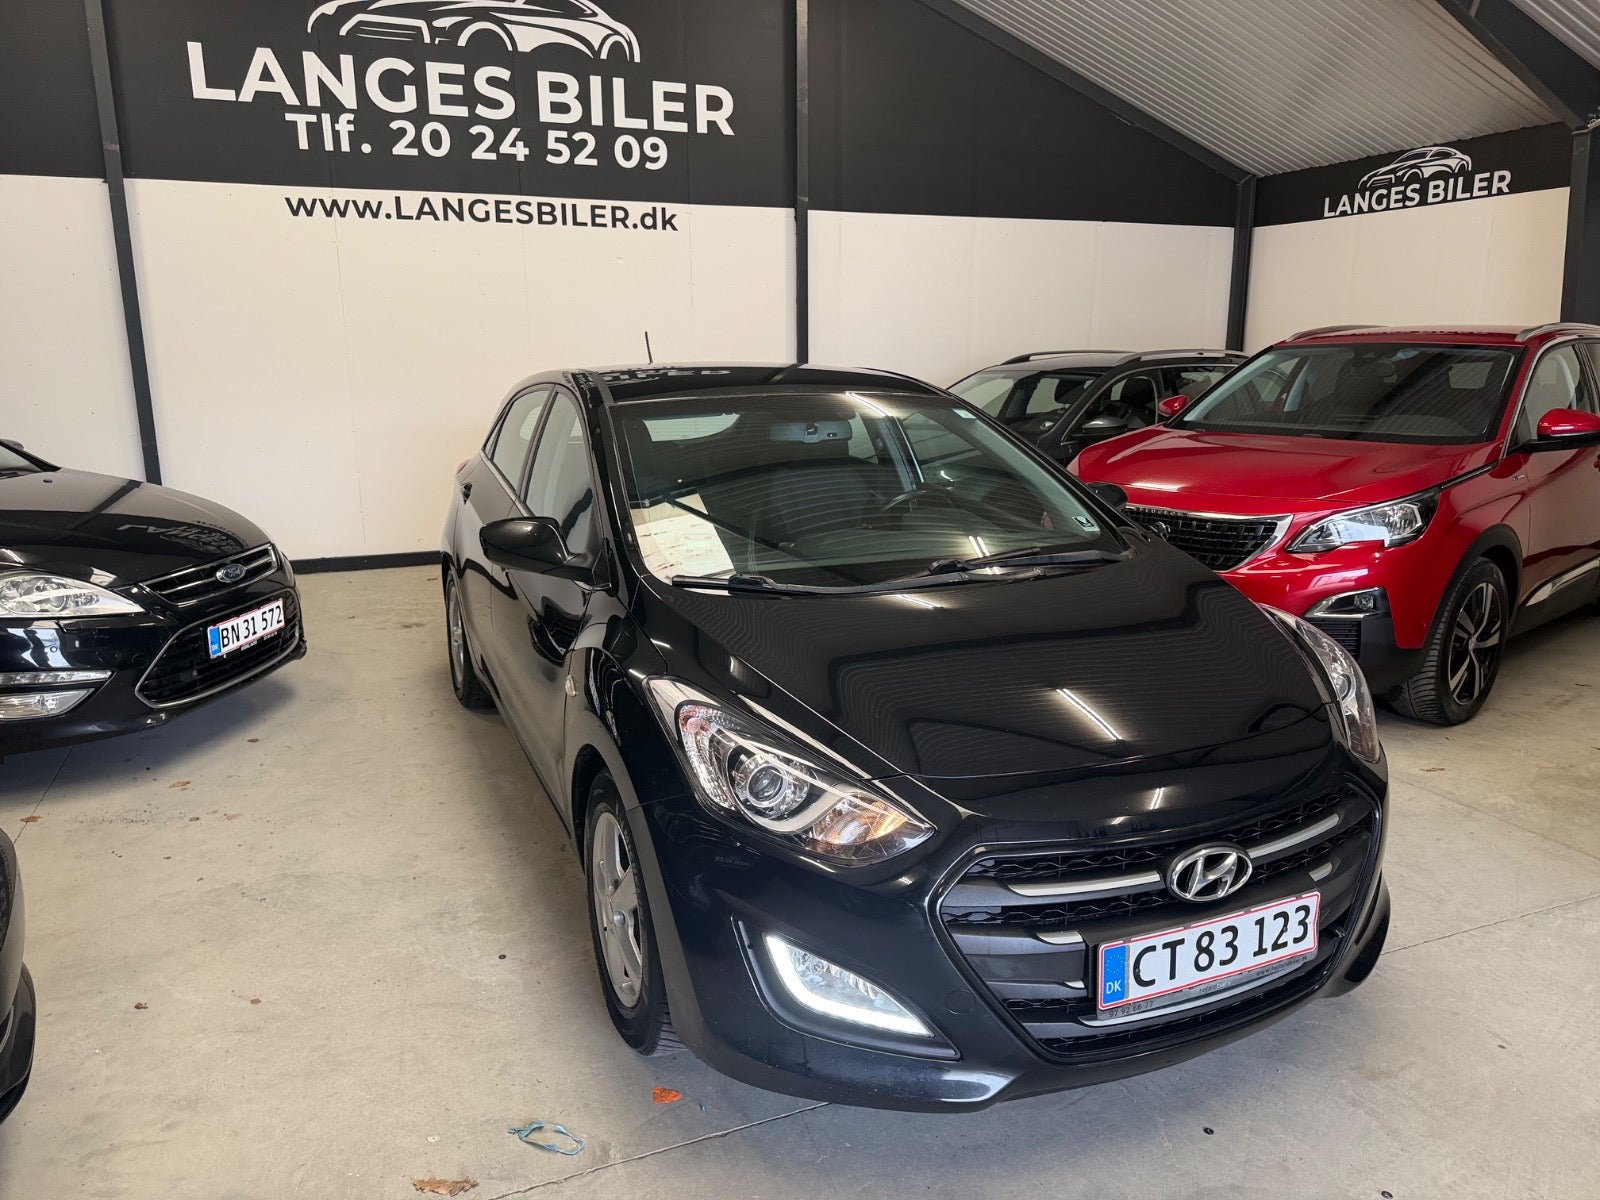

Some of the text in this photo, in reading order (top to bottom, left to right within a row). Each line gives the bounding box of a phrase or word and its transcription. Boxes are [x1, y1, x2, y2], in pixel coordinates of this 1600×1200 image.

[187, 42, 735, 136] LANGES BILER
[285, 112, 668, 171] Tlf. 20 24 52 09
[285, 198, 677, 231] www.LANGESBILER.dk
[1323, 170, 1512, 217] LANGES BILER
[221, 623, 240, 648] BN
[243, 616, 257, 639] 31
[261, 605, 282, 631] 572
[1133, 938, 1185, 987] CT
[1193, 925, 1239, 973] 83
[1253, 905, 1310, 957] 123
[1105, 980, 1122, 995] DK
